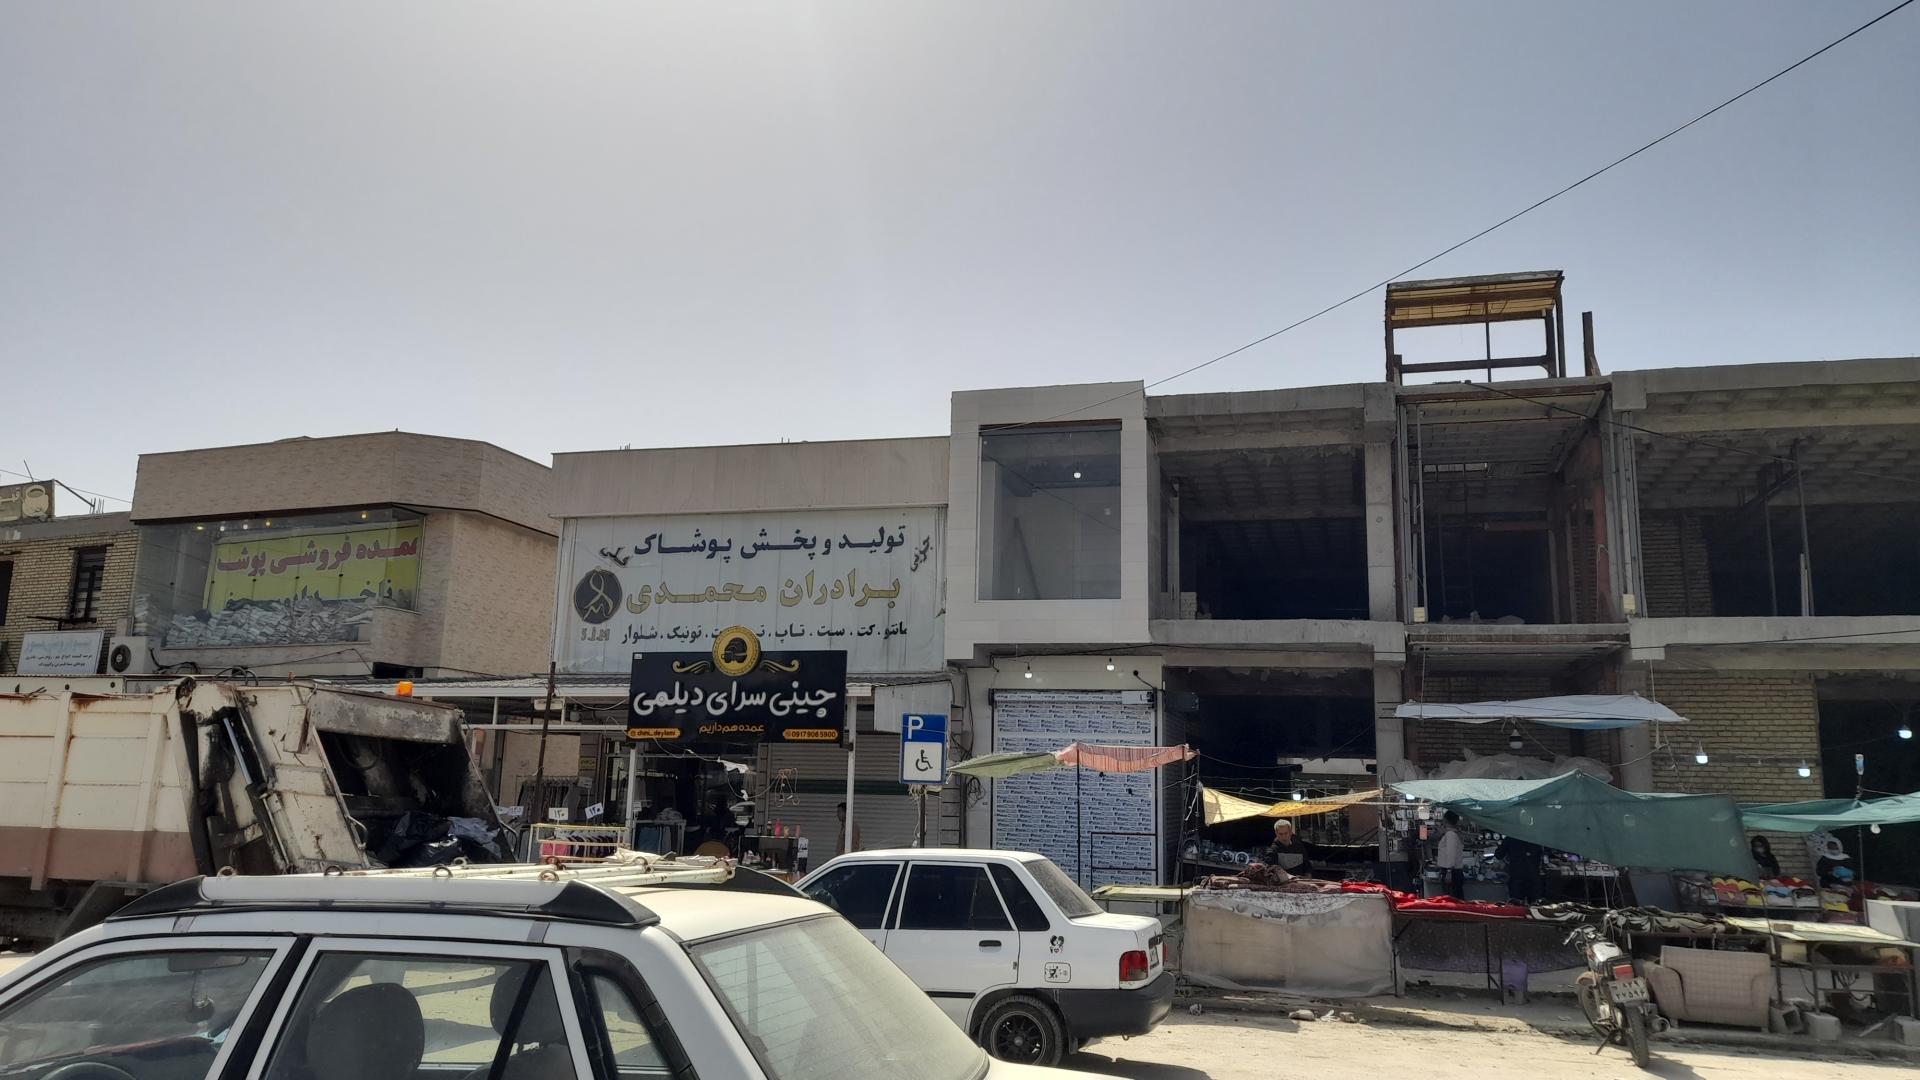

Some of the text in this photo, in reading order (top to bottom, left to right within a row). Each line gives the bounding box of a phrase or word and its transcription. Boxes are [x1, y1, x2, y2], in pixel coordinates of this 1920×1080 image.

[632, 523, 907, 563] تولید و پخش پوشاک
[269, 534, 353, 576] فروشی
[625, 567, 902, 615] برادران محمدی
[620, 624, 658, 645] شلوار
[666, 625, 703, 642] تونیک
[774, 624, 806, 642] تاپ
[816, 624, 846, 639] ست
[856, 622, 876, 638] کت
[633, 679, 838, 719] چینی سرای دیلمی
[698, 722, 766, 735] عمده هم داریم
[907, 715, 925, 740] P
